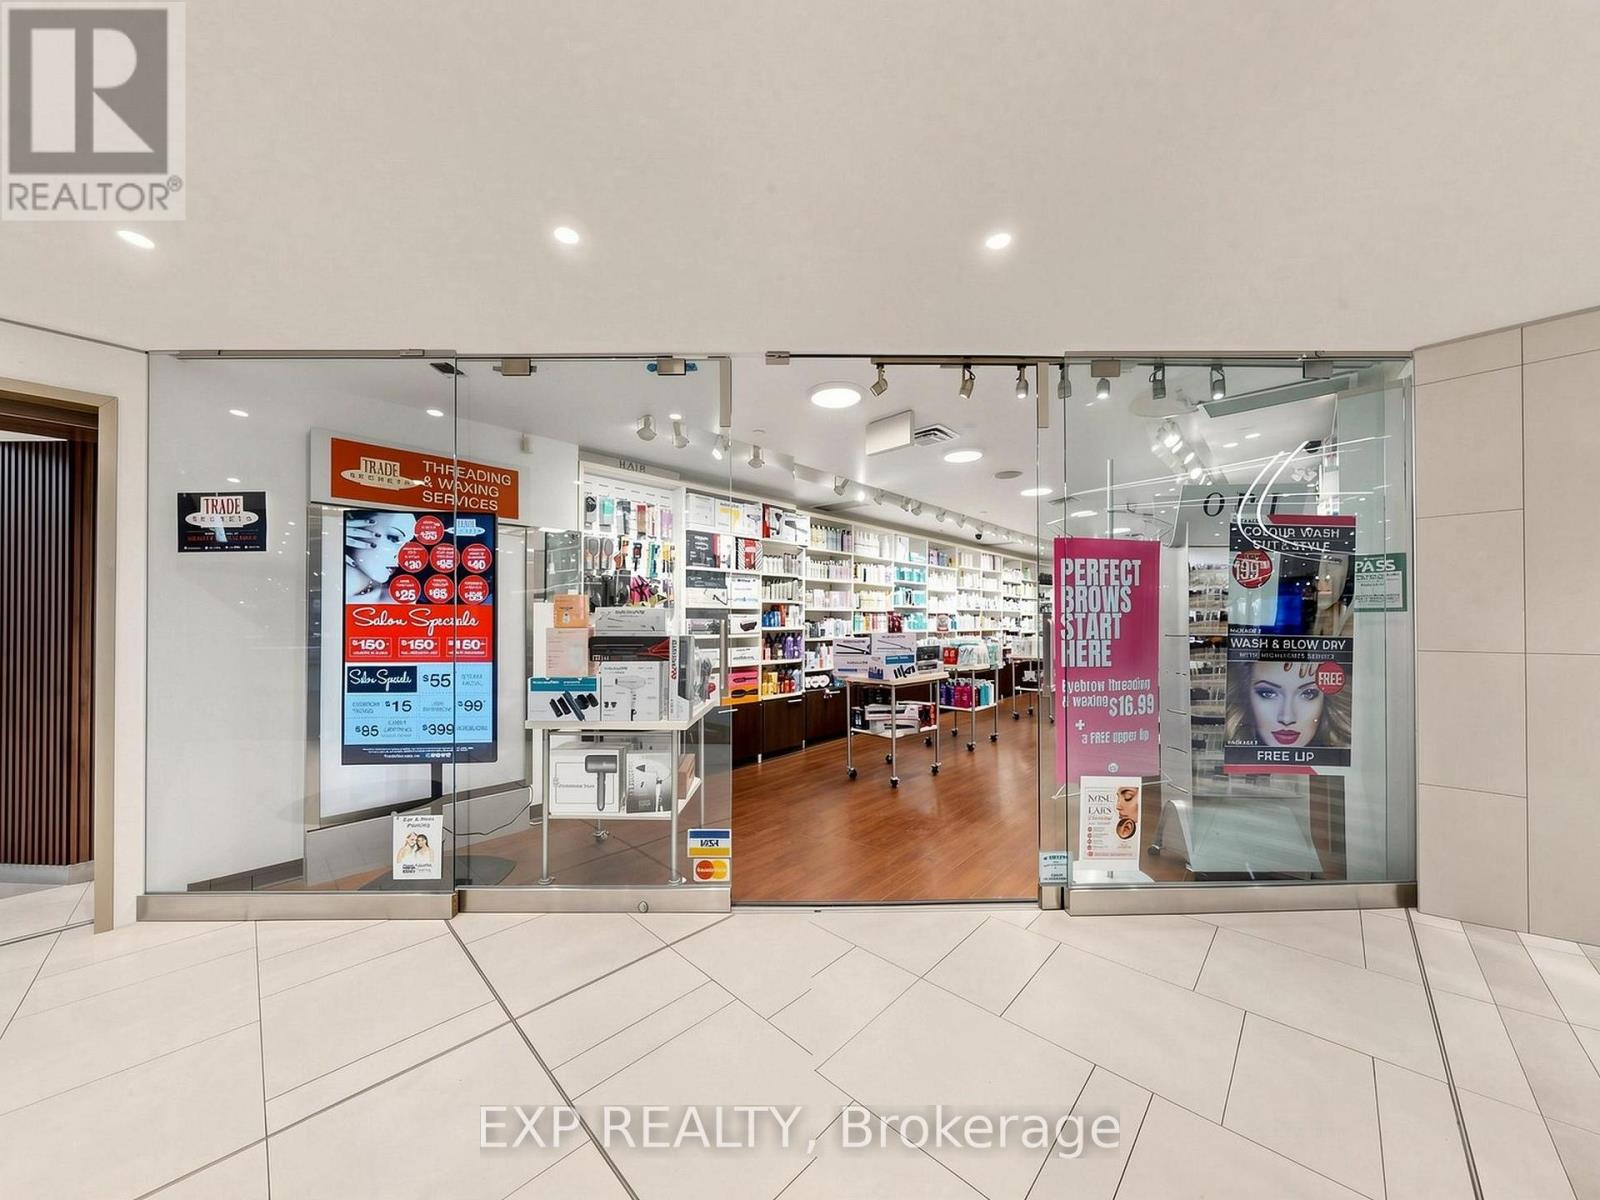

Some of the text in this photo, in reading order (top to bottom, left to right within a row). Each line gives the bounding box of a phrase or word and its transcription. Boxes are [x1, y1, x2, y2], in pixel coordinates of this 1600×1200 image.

[361, 459, 398, 478] TRADE
[422, 460, 512, 486] THREADING
[619, 459, 646, 473] HAIR
[423, 475, 500, 498] & WAXING
[203, 498, 241, 514] TRADE
[422, 491, 499, 511] SERVICES
[1244, 527, 1340, 538] COLOUR WASH
[1253, 540, 1279, 550] CUT
[1060, 558, 1142, 586] PERFECT
[1355, 560, 1396, 573] PASS
[1060, 585, 1132, 613] BROWS
[352, 607, 480, 636] Salon Specials
[1060, 613, 1122, 640] START
[1230, 638, 1347, 651] WASH & BLOW DRY
[1060, 640, 1113, 667] HERE
[422, 674, 451, 688] $55
[1318, 672, 1343, 686] FREE
[385, 700, 413, 712] $15
[457, 700, 483, 712] $99
[1109, 694, 1155, 717] $16.99
[422, 724, 454, 736] $399
[1081, 734, 1088, 744] a
[1090, 731, 1110, 744] FREE
[1113, 731, 1137, 745] upper
[1257, 751, 1315, 762] FREE LIP
[700, 839, 720, 847] VISA
